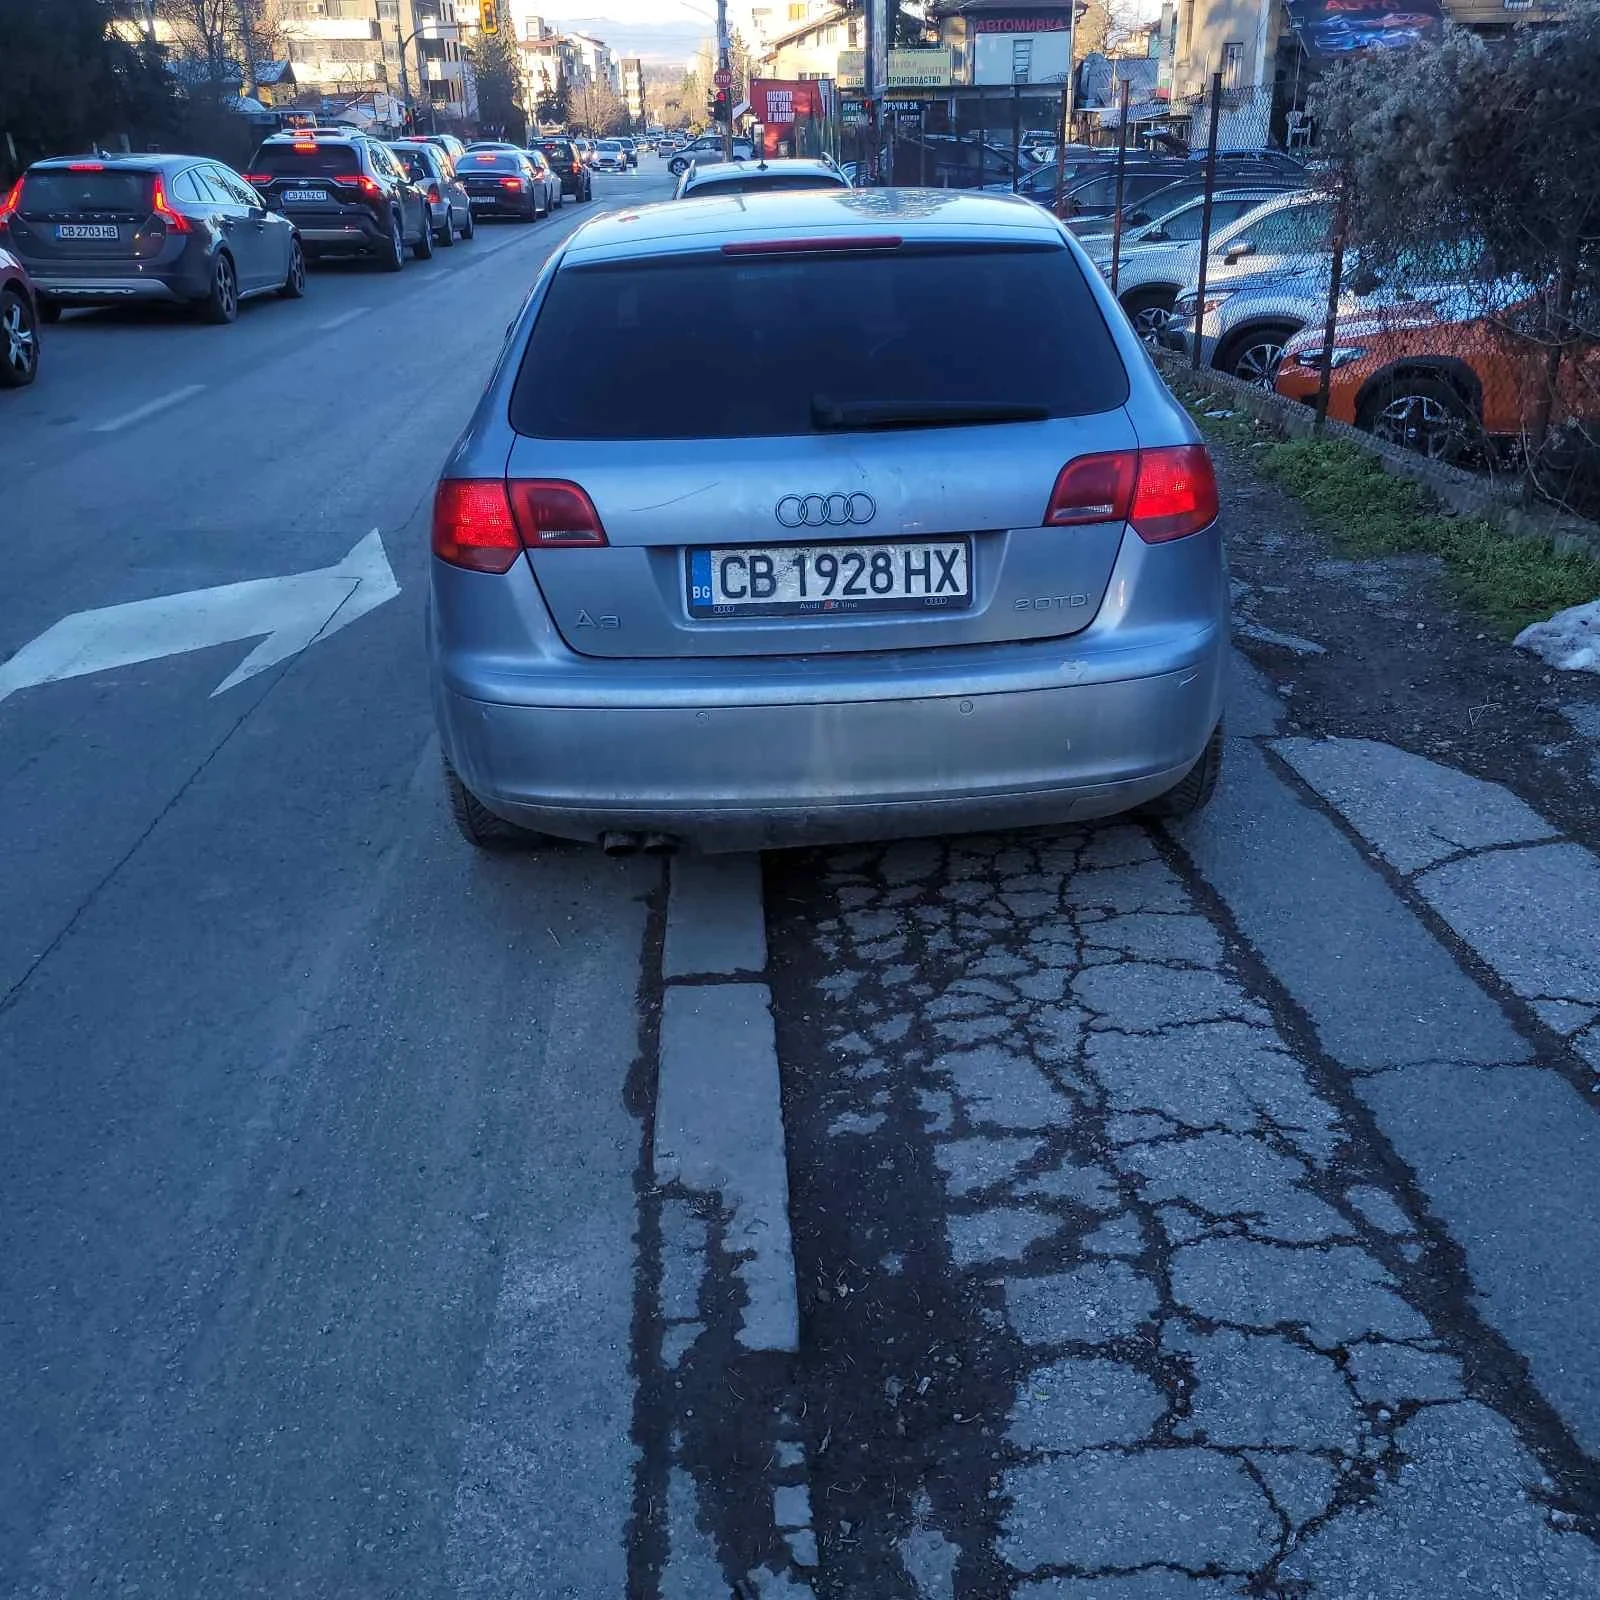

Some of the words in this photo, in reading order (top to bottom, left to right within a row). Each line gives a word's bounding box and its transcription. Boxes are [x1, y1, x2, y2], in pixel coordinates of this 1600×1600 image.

[715, 75, 731, 83] STOP
[883, 102, 908, 110] ОРЪЧКИ
[62, 226, 75, 237] CB
[77, 226, 102, 237] 2703
[102, 226, 116, 237] HB
[692, 586, 711, 600] BG
[719, 555, 777, 600] CB
[792, 552, 894, 598] 1928
[903, 549, 961, 594] HX
[576, 609, 621, 630] A3
